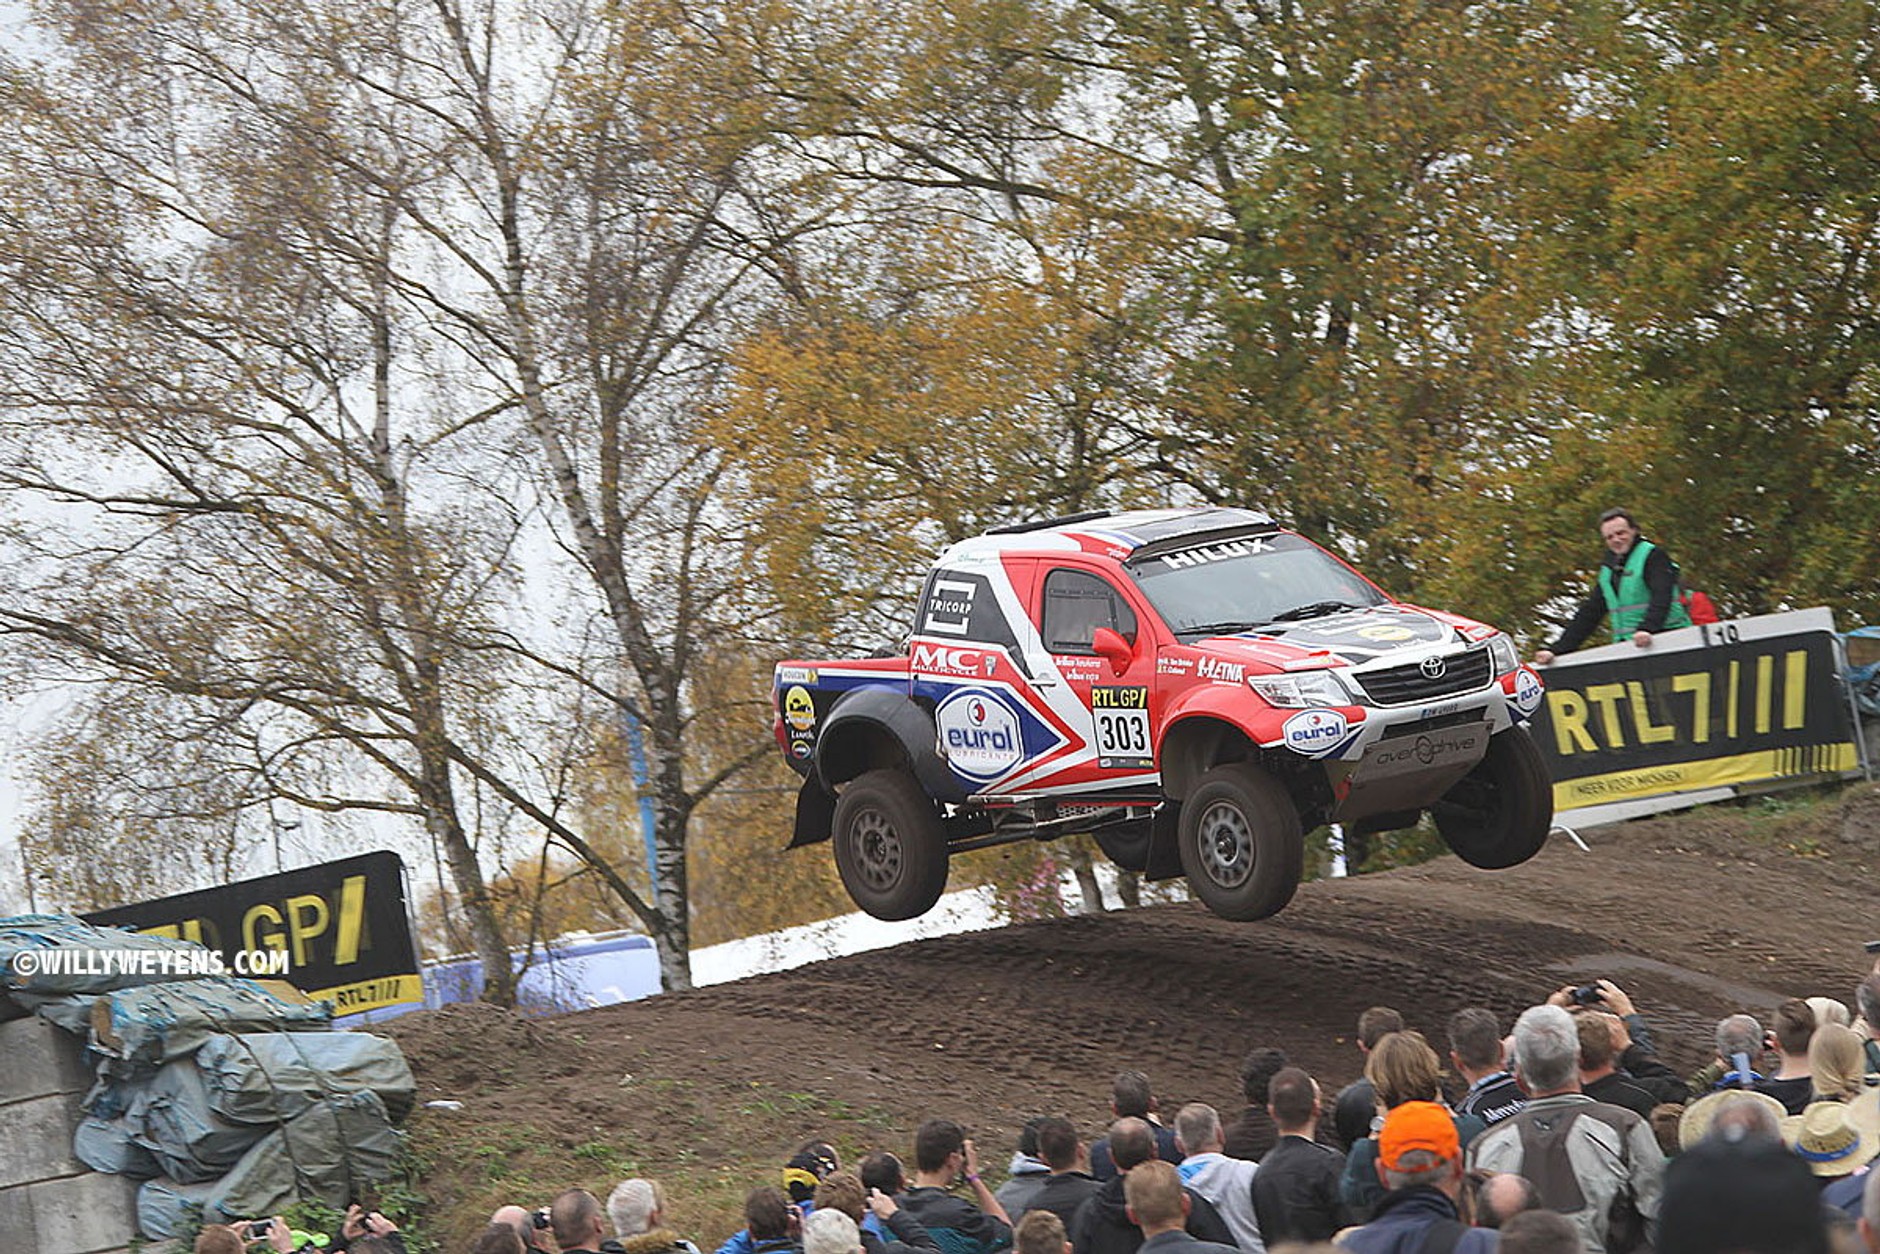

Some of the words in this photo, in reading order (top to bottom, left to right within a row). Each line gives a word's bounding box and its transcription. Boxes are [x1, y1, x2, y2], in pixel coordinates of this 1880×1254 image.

[1160, 537, 1275, 570] HILUX
[930, 598, 972, 615] TRICORP
[912, 645, 982, 671] MC
[1092, 688, 1119, 707] RTL
[1121, 688, 1139, 707] GP
[948, 723, 1014, 752] eurol
[1101, 716, 1146, 751] 303
[1292, 722, 1341, 741] eurol
[242, 895, 329, 974] GP
